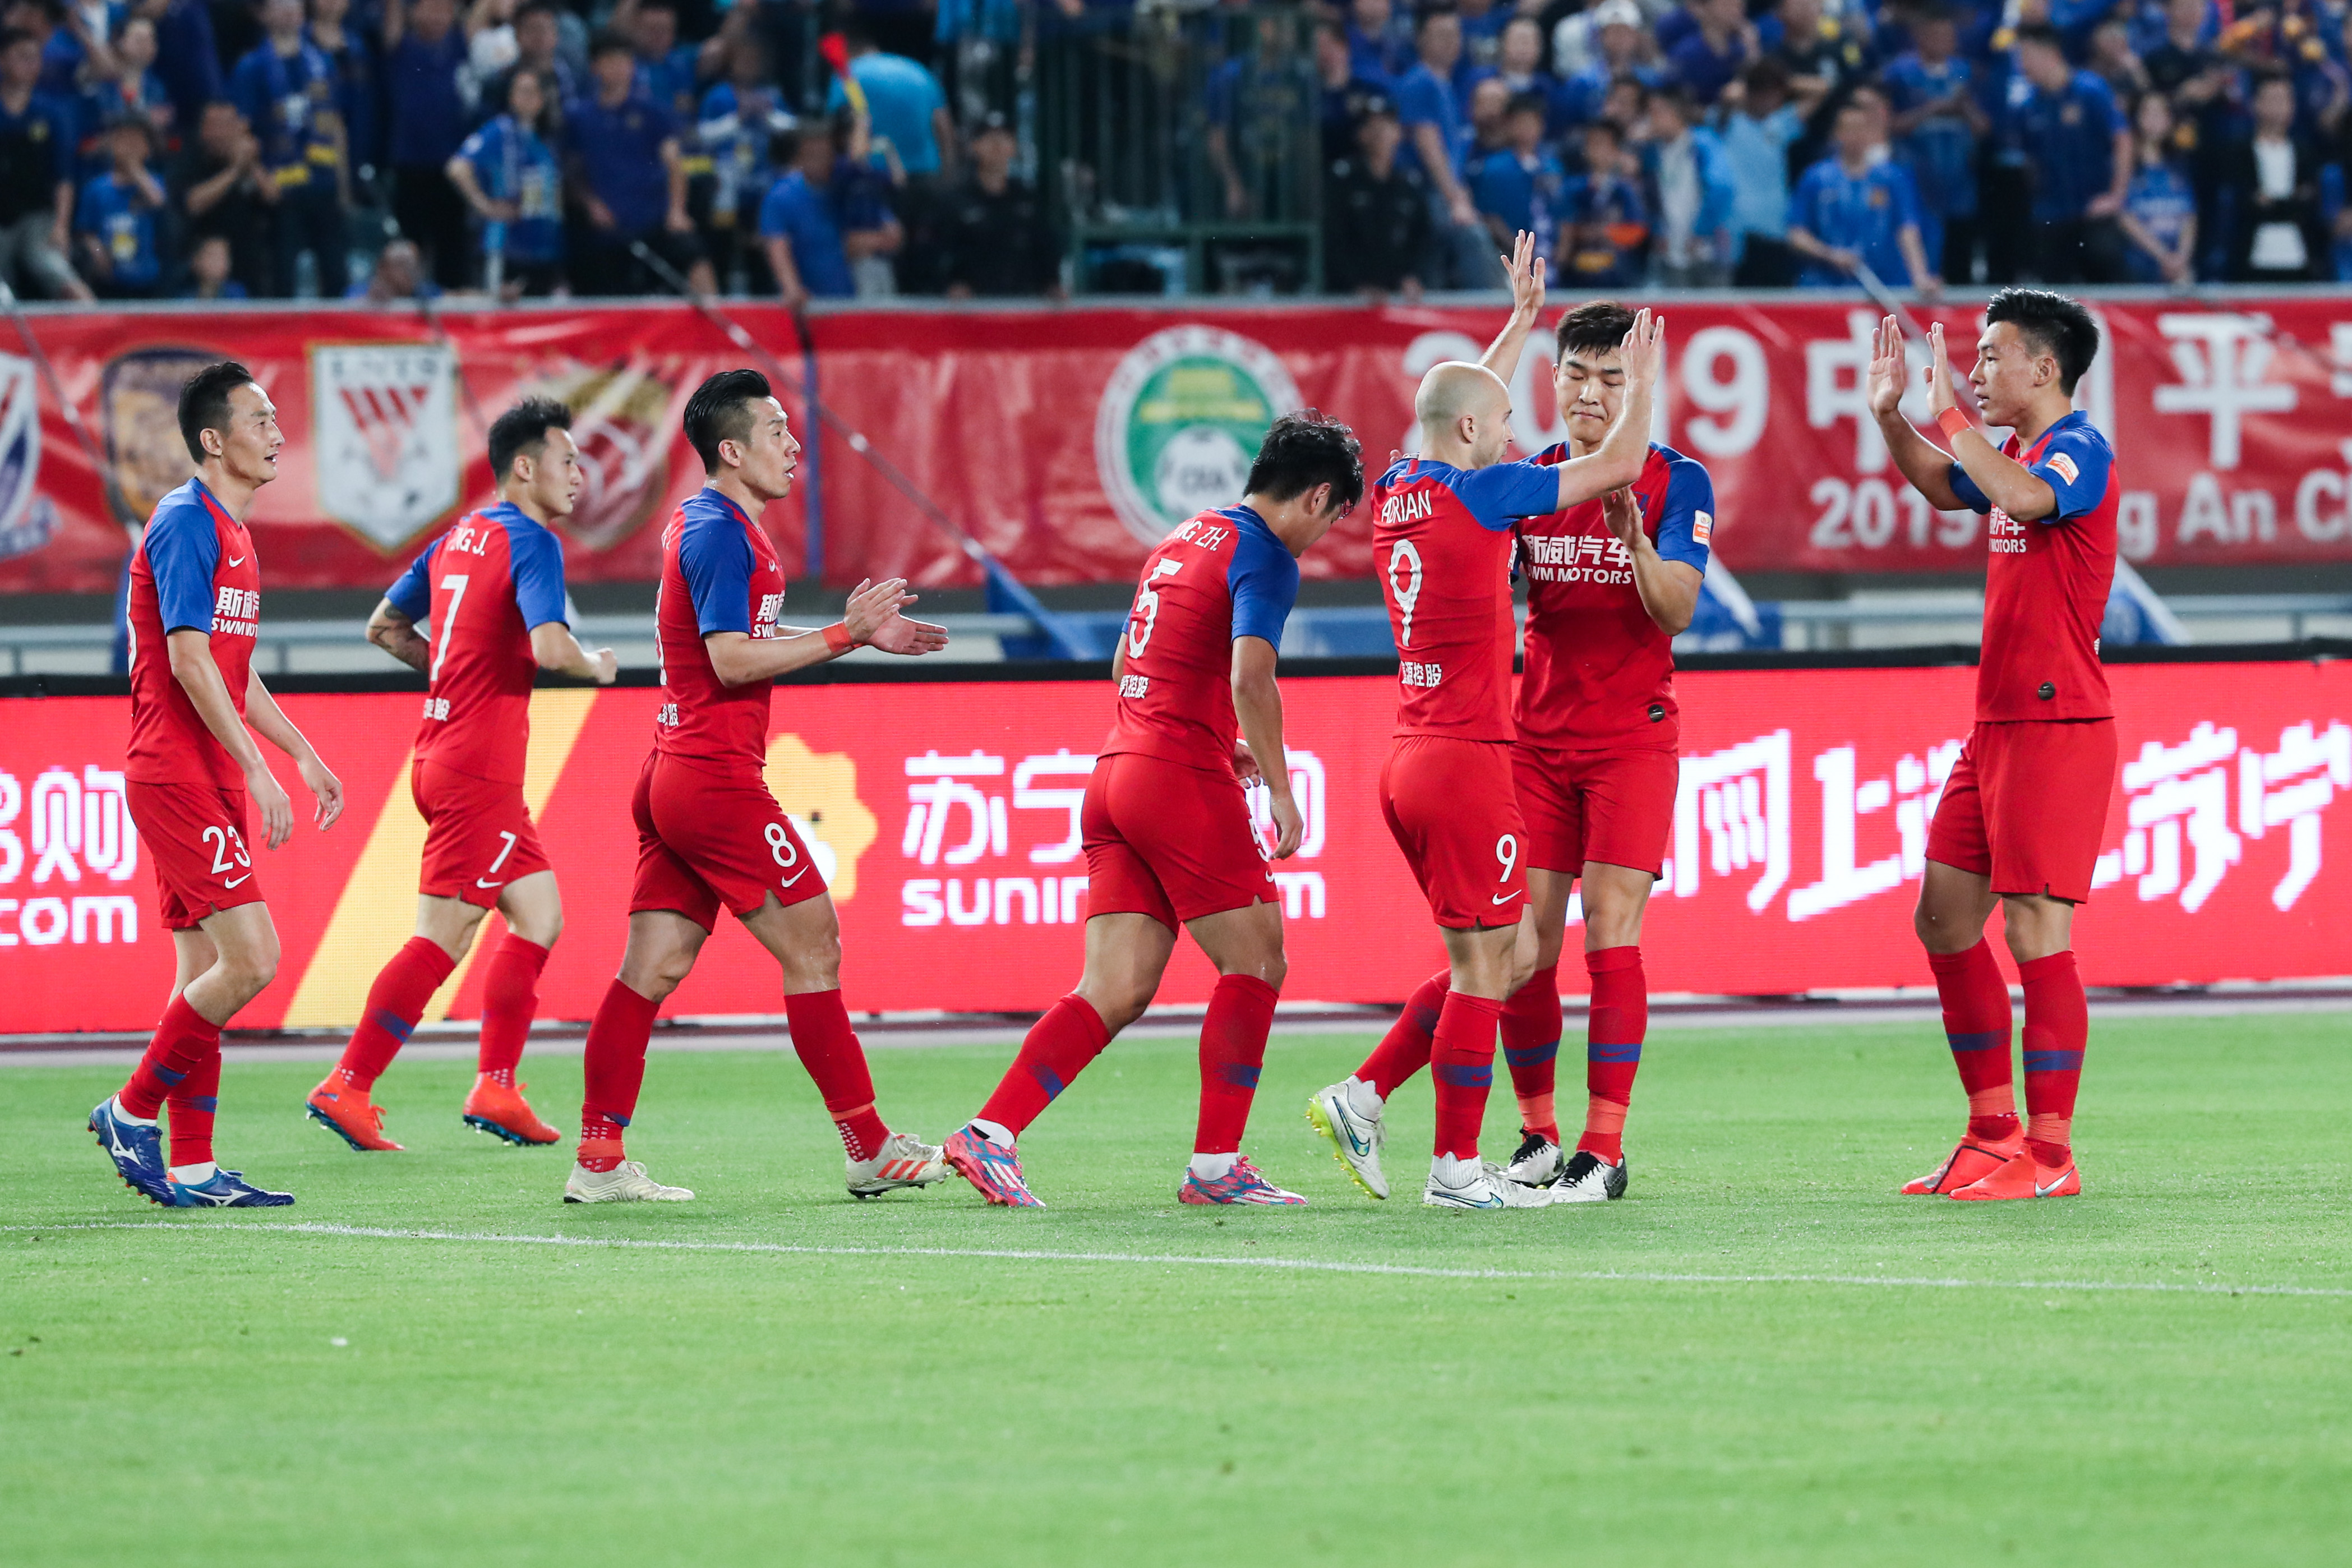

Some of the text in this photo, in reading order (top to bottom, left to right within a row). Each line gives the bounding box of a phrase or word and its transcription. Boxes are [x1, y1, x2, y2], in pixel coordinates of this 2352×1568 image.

[2179, 472, 2279, 543] An
[1388, 539, 1423, 647] 9
[1557, 567, 1632, 584] MOTORS
[430, 574, 470, 682] 7
[1129, 557, 1184, 660] 5
[202, 825, 252, 874] 23
[488, 830, 517, 874] 7
[763, 822, 797, 868] 8
[1496, 833, 1518, 883] 9
